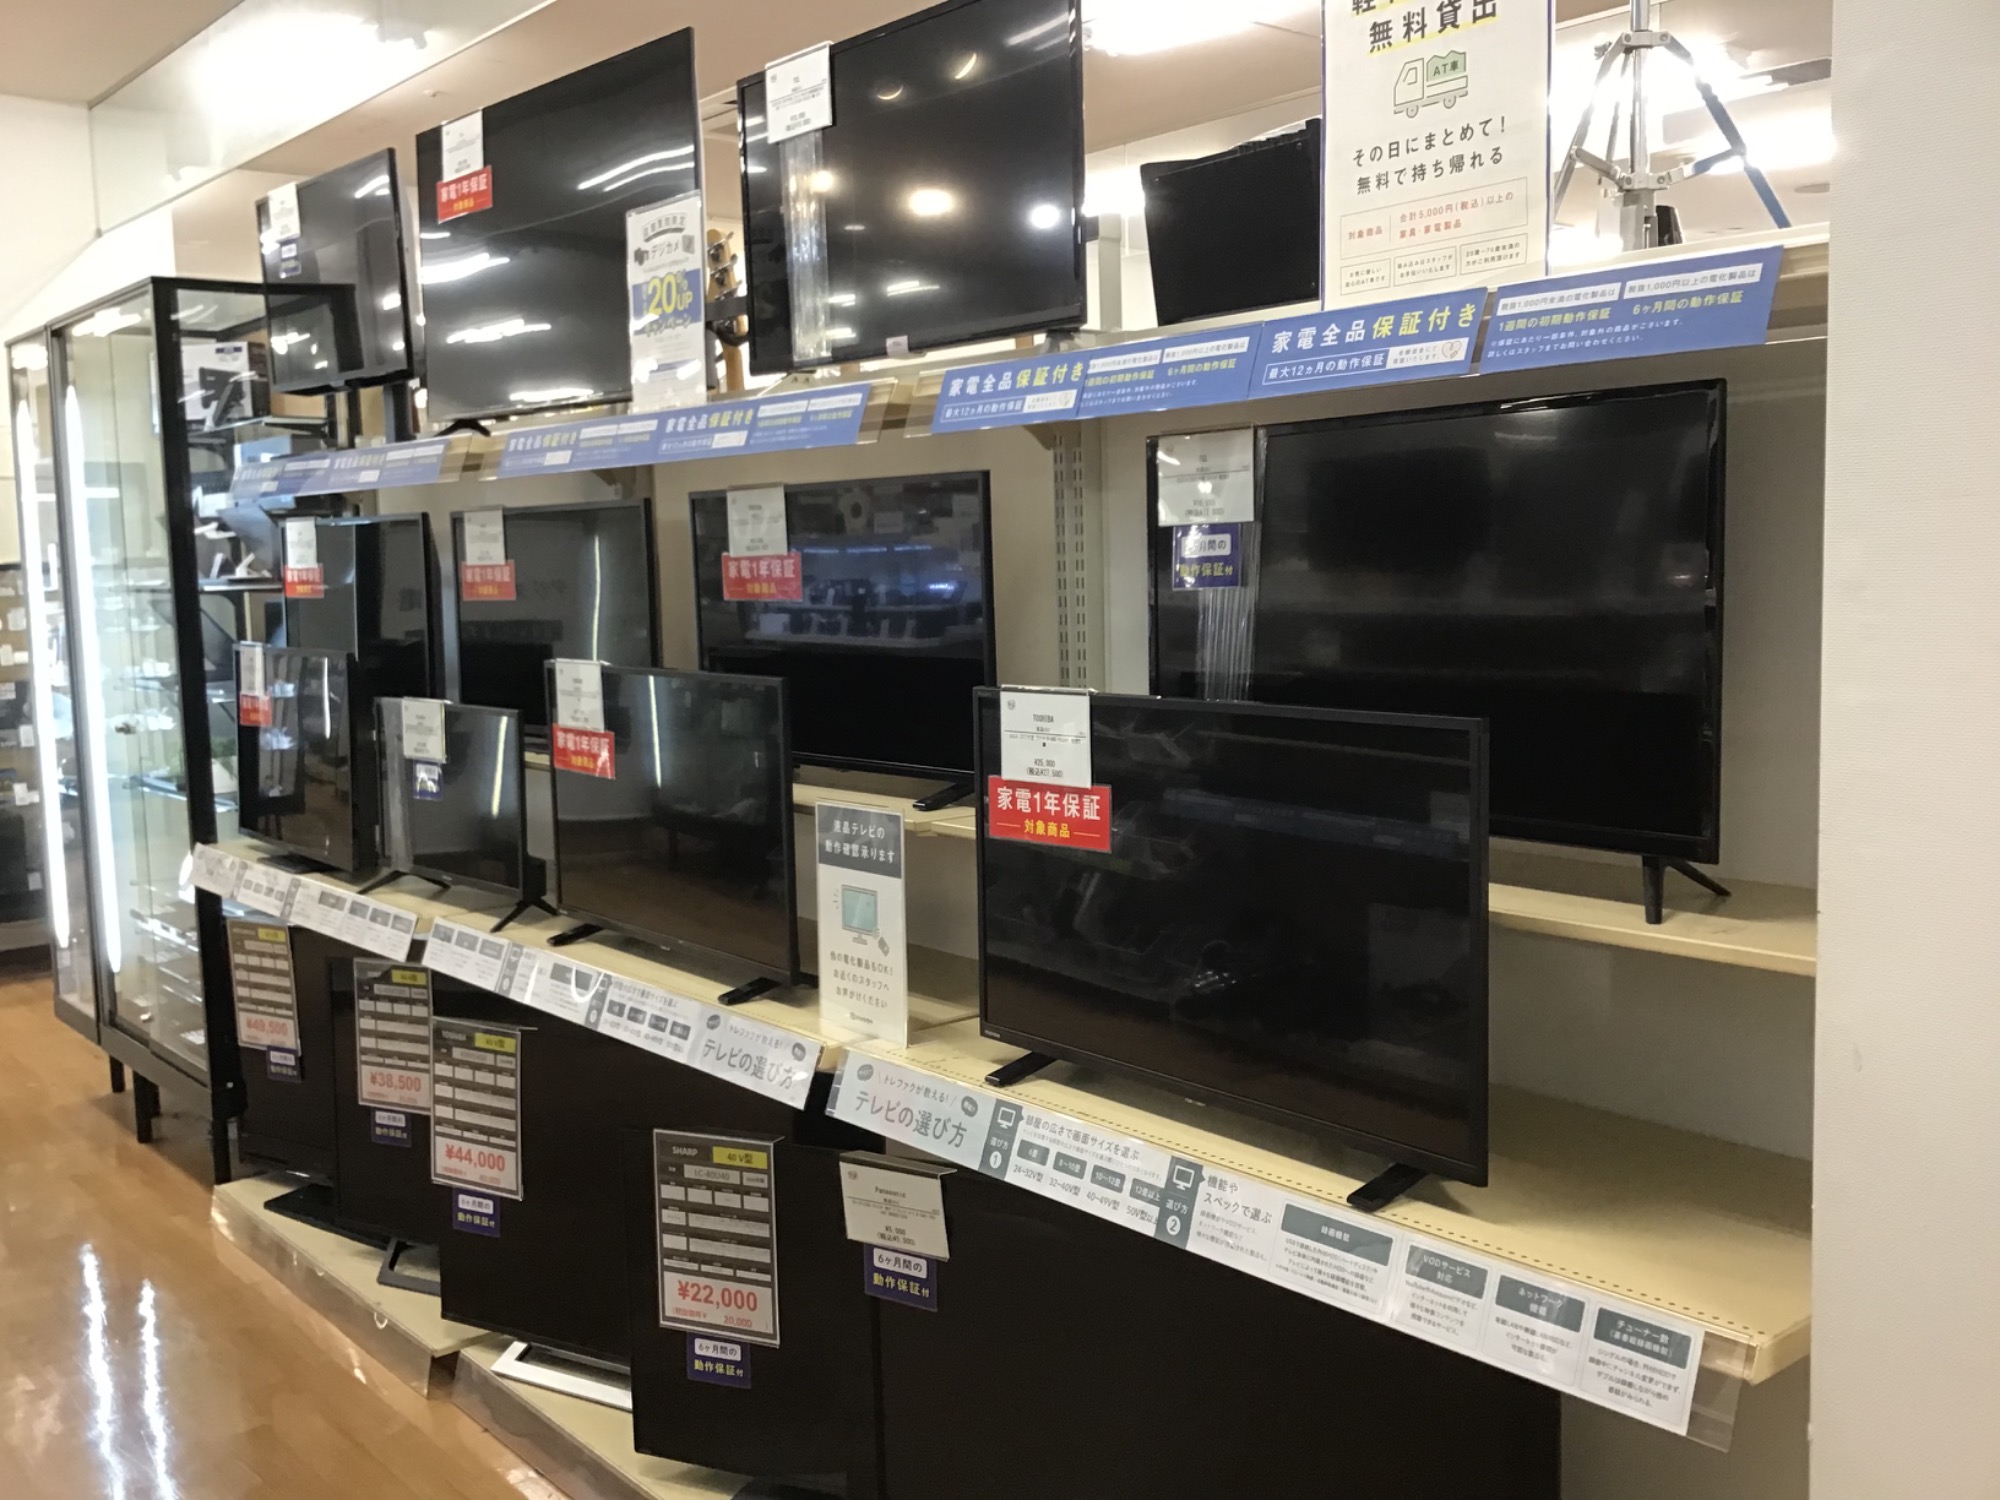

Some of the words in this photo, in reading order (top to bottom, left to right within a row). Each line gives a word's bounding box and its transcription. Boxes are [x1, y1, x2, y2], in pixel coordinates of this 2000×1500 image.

[1369, 0, 1497, 53] 無料貸出
[1433, 59, 1459, 77] AT車
[1356, 146, 1503, 195] 無料で持ち帰れる
[1272, 303, 1477, 354] 家電全品保証付き
[949, 362, 1084, 397] 家電全品保証付き
[997, 786, 1101, 820] 家電1年保証
[833, 819, 886, 840] 液晶テレビの
[1024, 818, 1071, 838] 対象商品
[703, 1038, 796, 1090] テレビの選び方
[370, 1071, 422, 1092] ¥38,500
[855, 1089, 968, 1149] テレビの選び方
[445, 1143, 505, 1172] ¥44,000
[672, 1146, 698, 1157] SHARP
[1207, 1175, 1239, 1193] 機能や
[1165, 1199, 1189, 1215] 選び方
[1204, 1193, 1273, 1224] スペックで選ぶ
[1423, 1255, 1470, 1278] VODサービス
[677, 1280, 758, 1311] ¥22,000
[872, 1272, 930, 1298] 動作保証付
